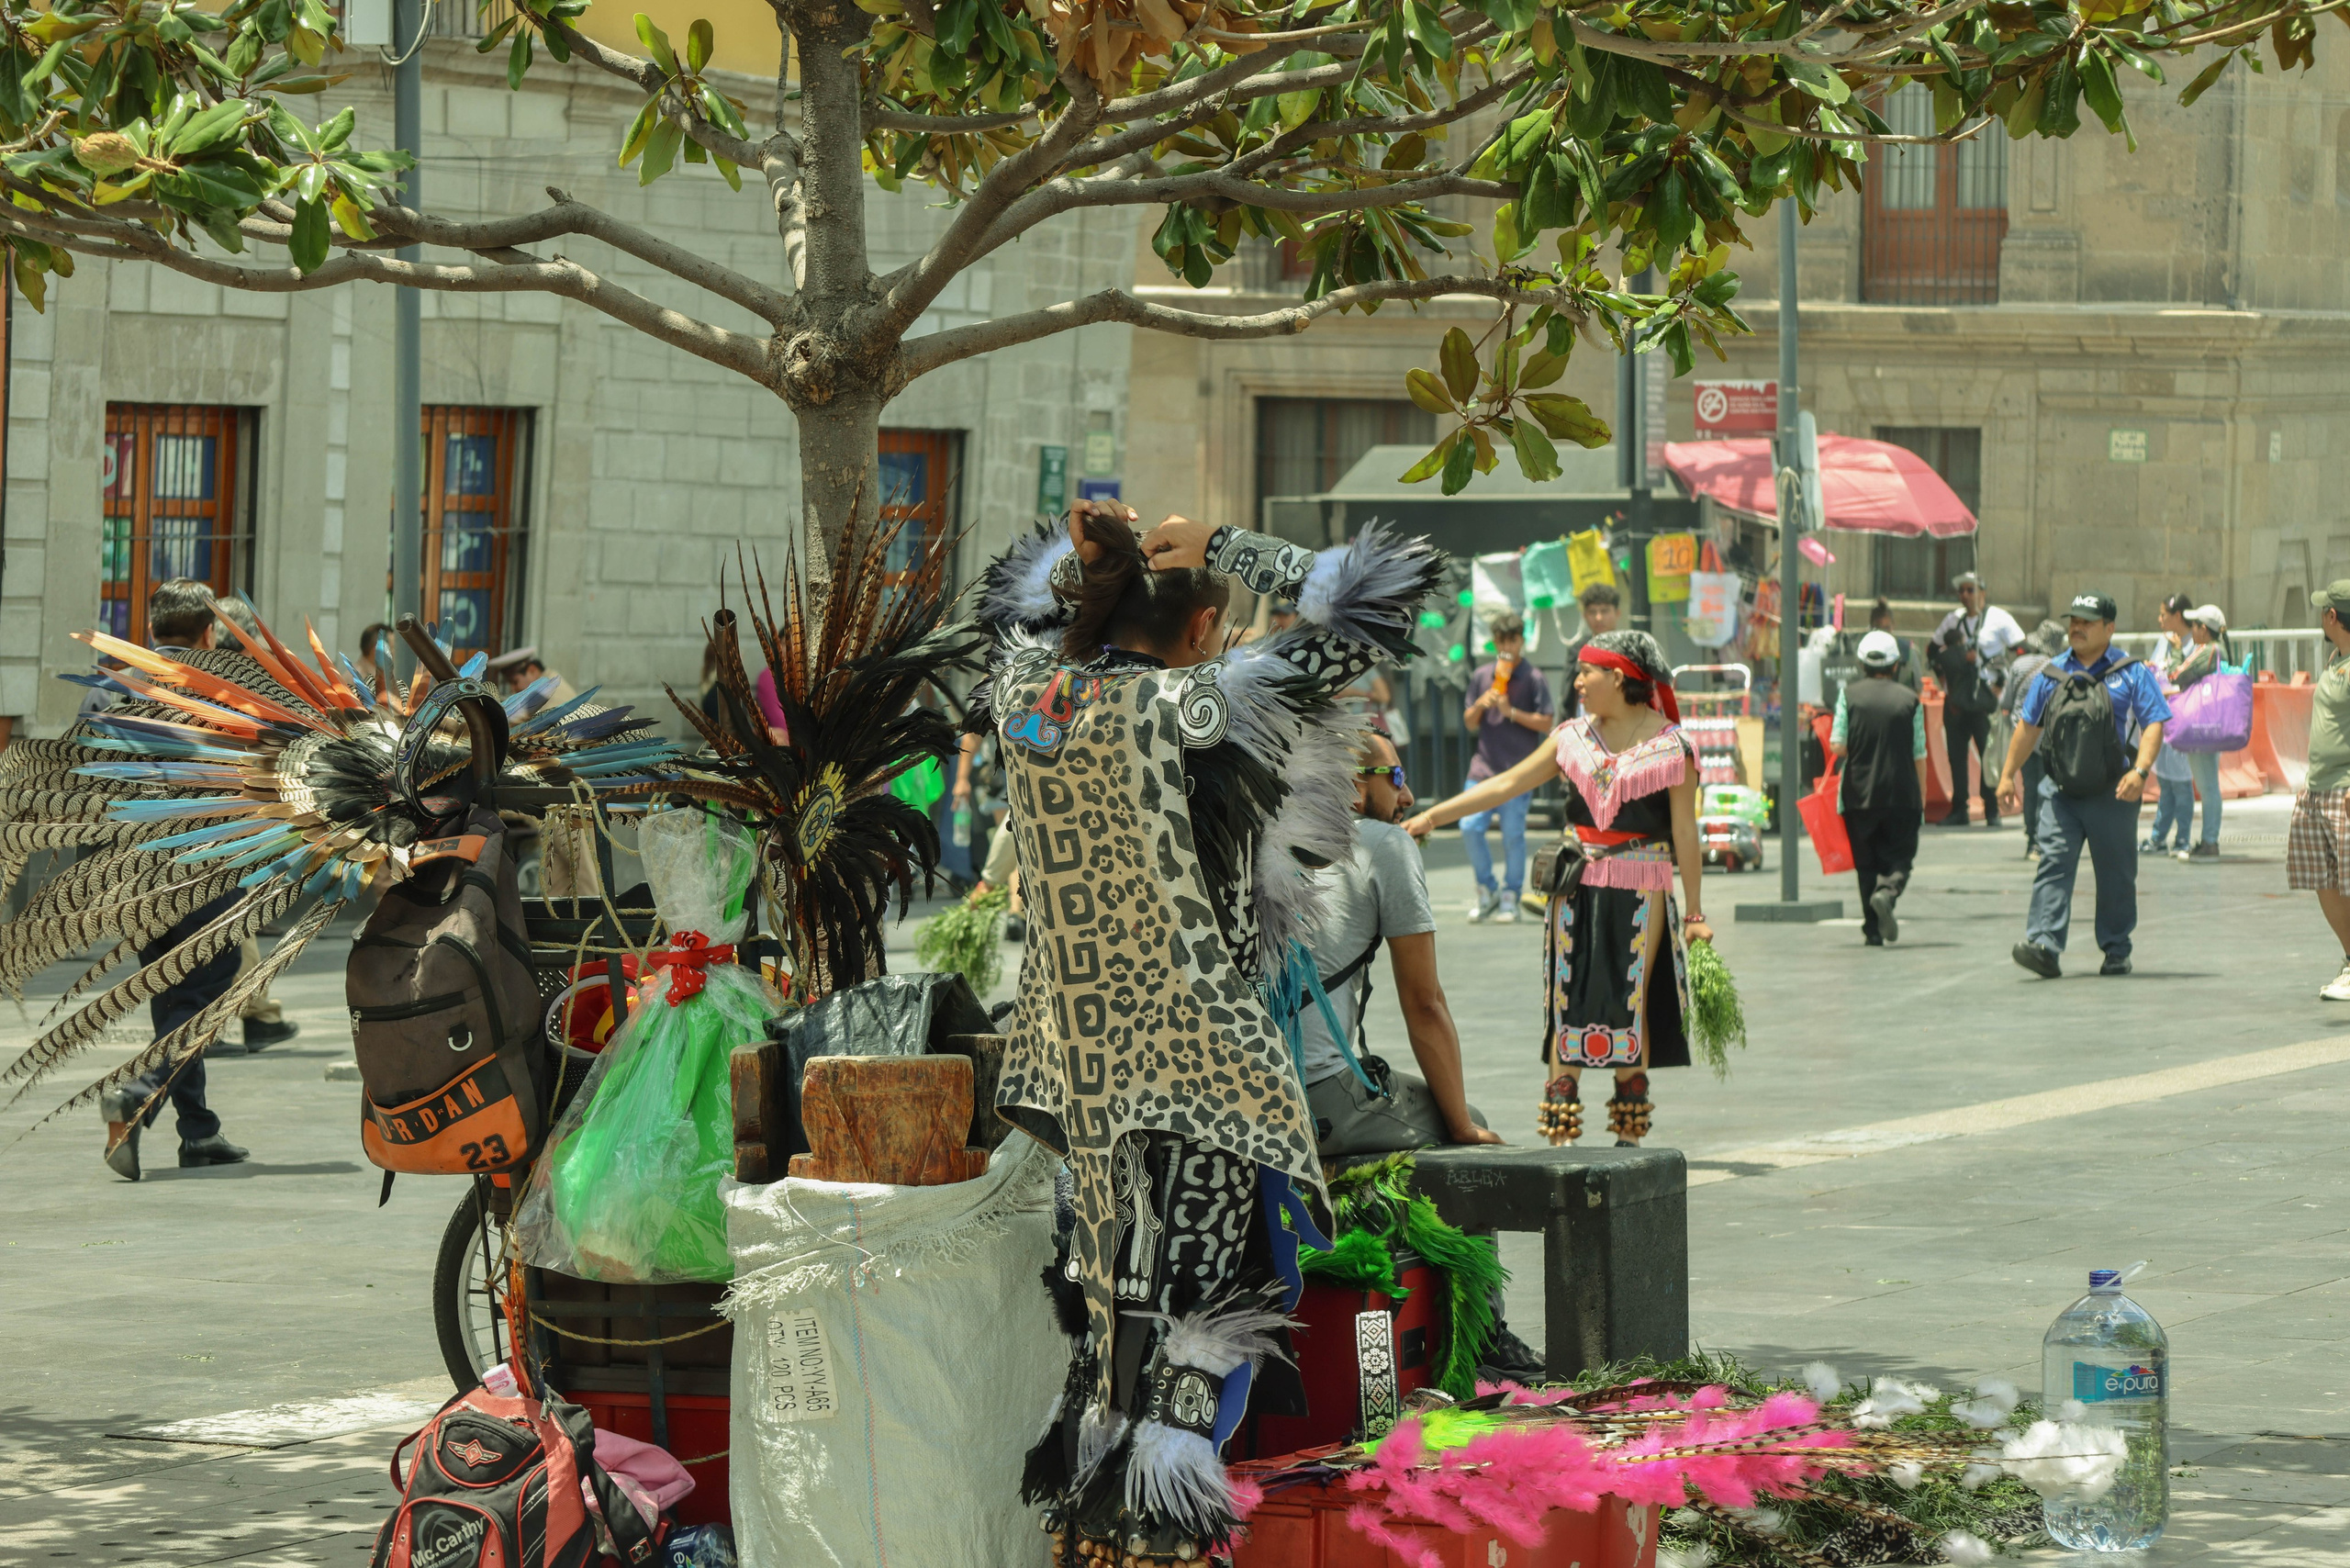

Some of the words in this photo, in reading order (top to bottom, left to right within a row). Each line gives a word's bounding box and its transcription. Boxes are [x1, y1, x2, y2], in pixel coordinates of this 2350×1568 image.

[376, 1078, 486, 1141] ORDAN
[460, 1133, 512, 1170] 23
[770, 1357, 791, 1378] 120
[773, 1385, 797, 1411] PCS
[410, 1517, 485, 1568] Mc.Carthy
